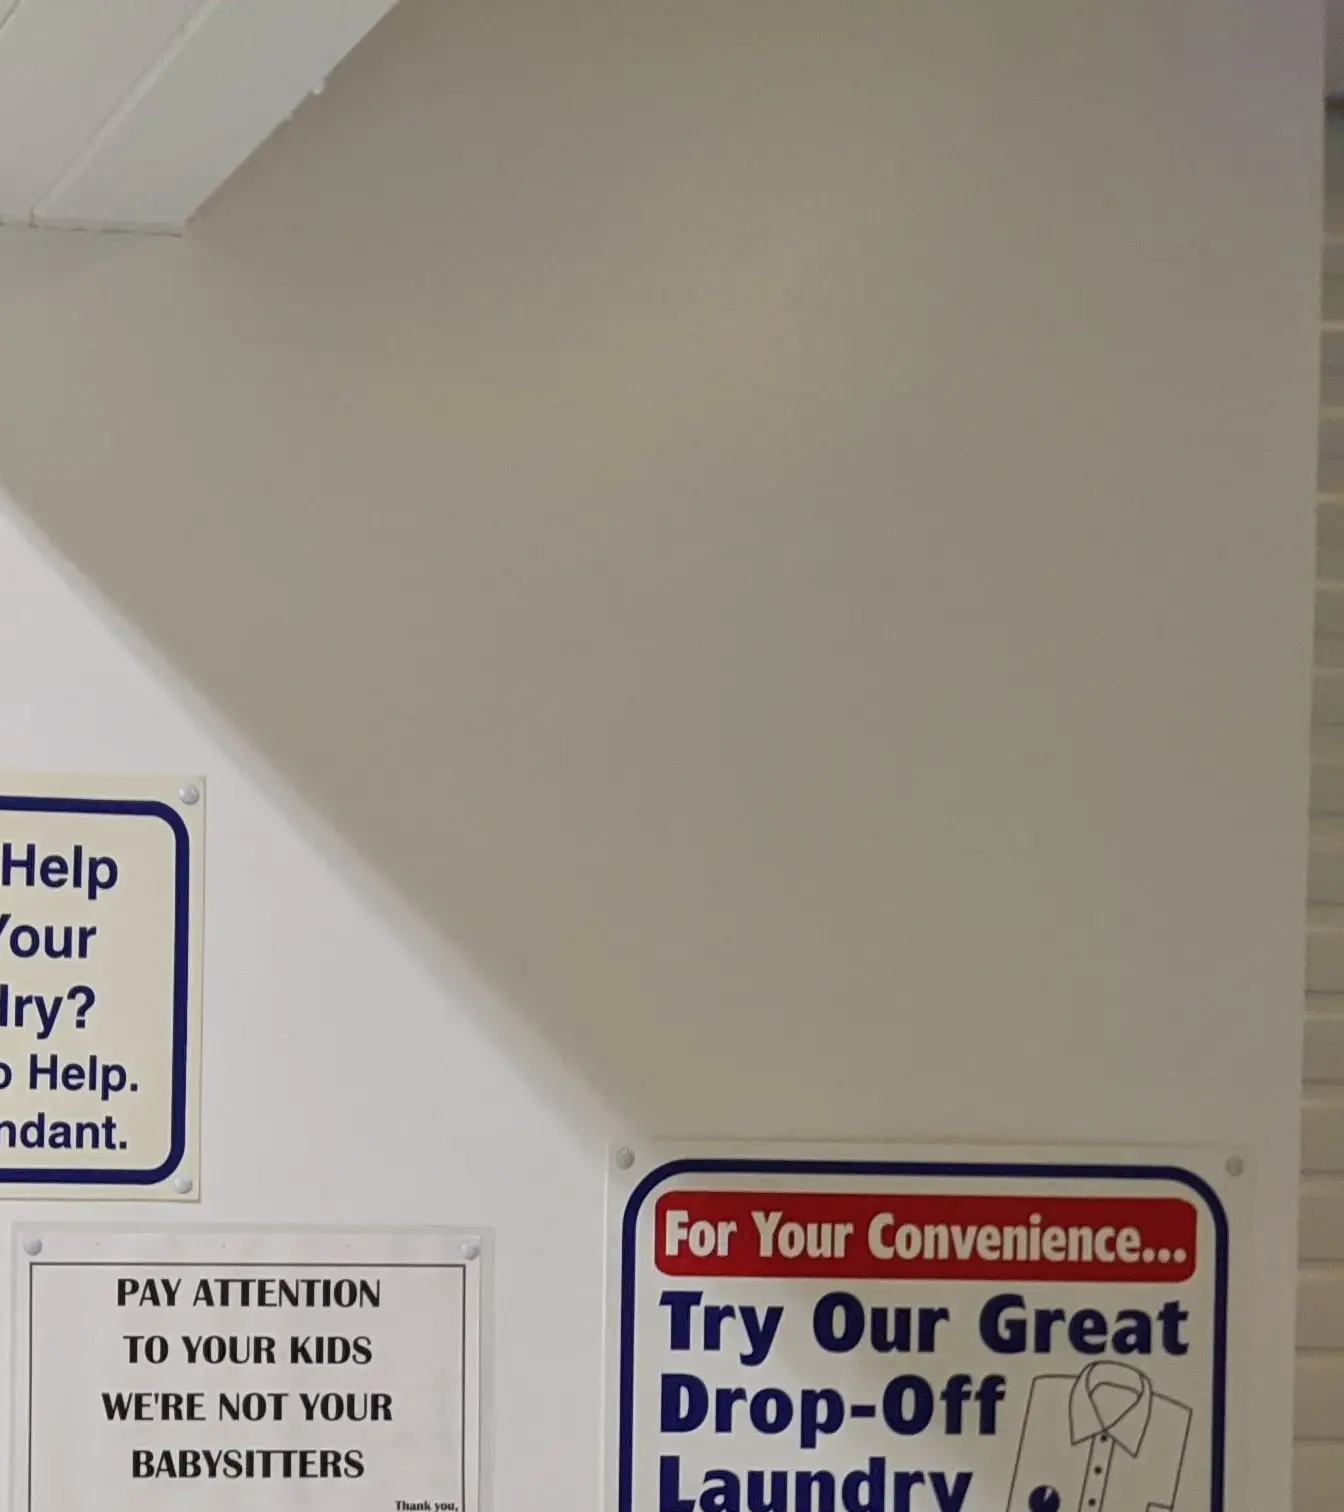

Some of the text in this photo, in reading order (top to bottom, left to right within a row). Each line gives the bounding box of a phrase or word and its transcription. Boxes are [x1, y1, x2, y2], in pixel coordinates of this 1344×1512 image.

[2, 843, 118, 900] Help
[29, 1054, 138, 1101] Help.
[665, 1210, 1186, 1263] For Your Convenience...
[118, 1279, 380, 1308] PAY ATTENTION
[123, 1335, 372, 1364] TO YOUR KIDS
[659, 1291, 1189, 1367] Try Our Great
[102, 1393, 392, 1421] WE'RE NOT YOUR
[660, 1373, 1008, 1449] Drop-Off
[133, 1450, 364, 1479] BABYSITTERS
